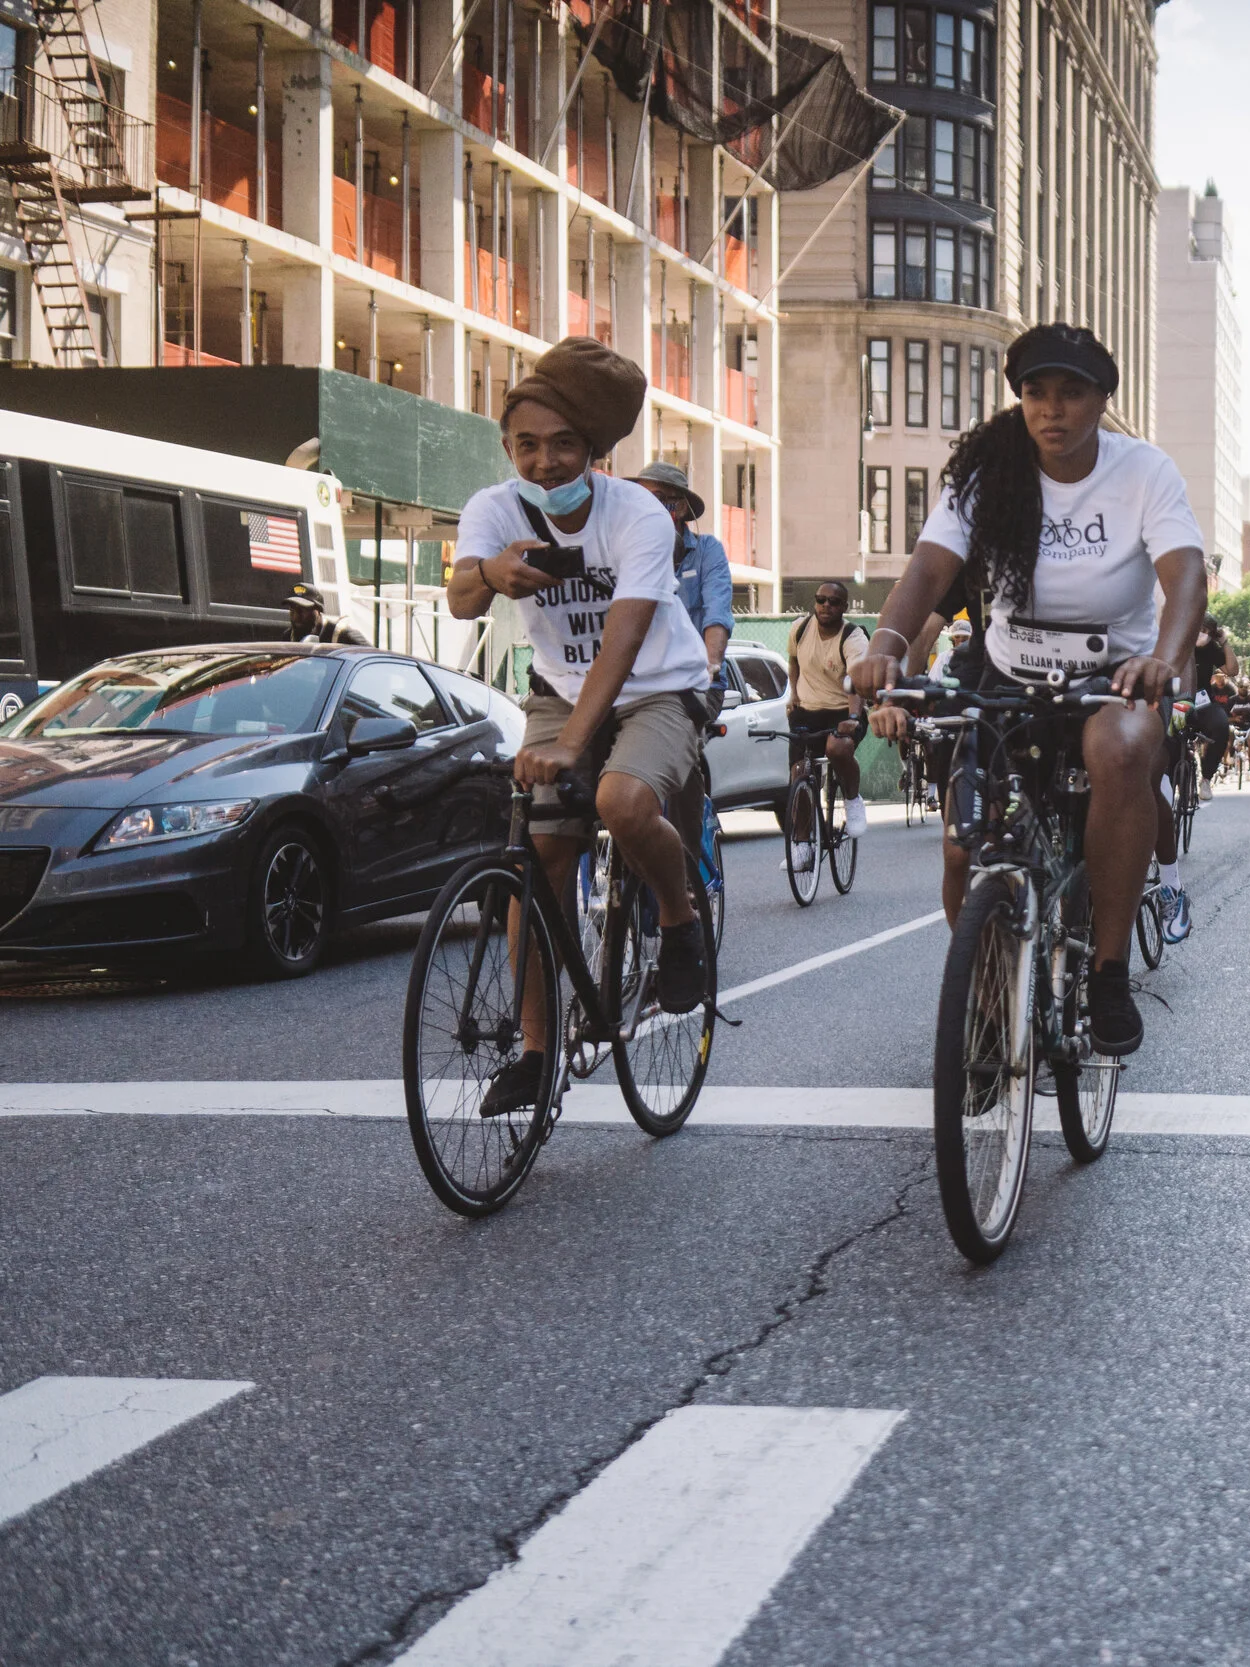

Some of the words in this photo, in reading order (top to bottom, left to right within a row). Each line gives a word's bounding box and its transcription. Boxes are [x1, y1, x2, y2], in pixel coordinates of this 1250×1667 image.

[534, 577, 614, 608] SOLIDA
[567, 610, 609, 636] WIT
[563, 639, 602, 664] BLA
[1009, 633, 1043, 645] LIVES
[1020, 654, 1053, 669] ELIJAH
